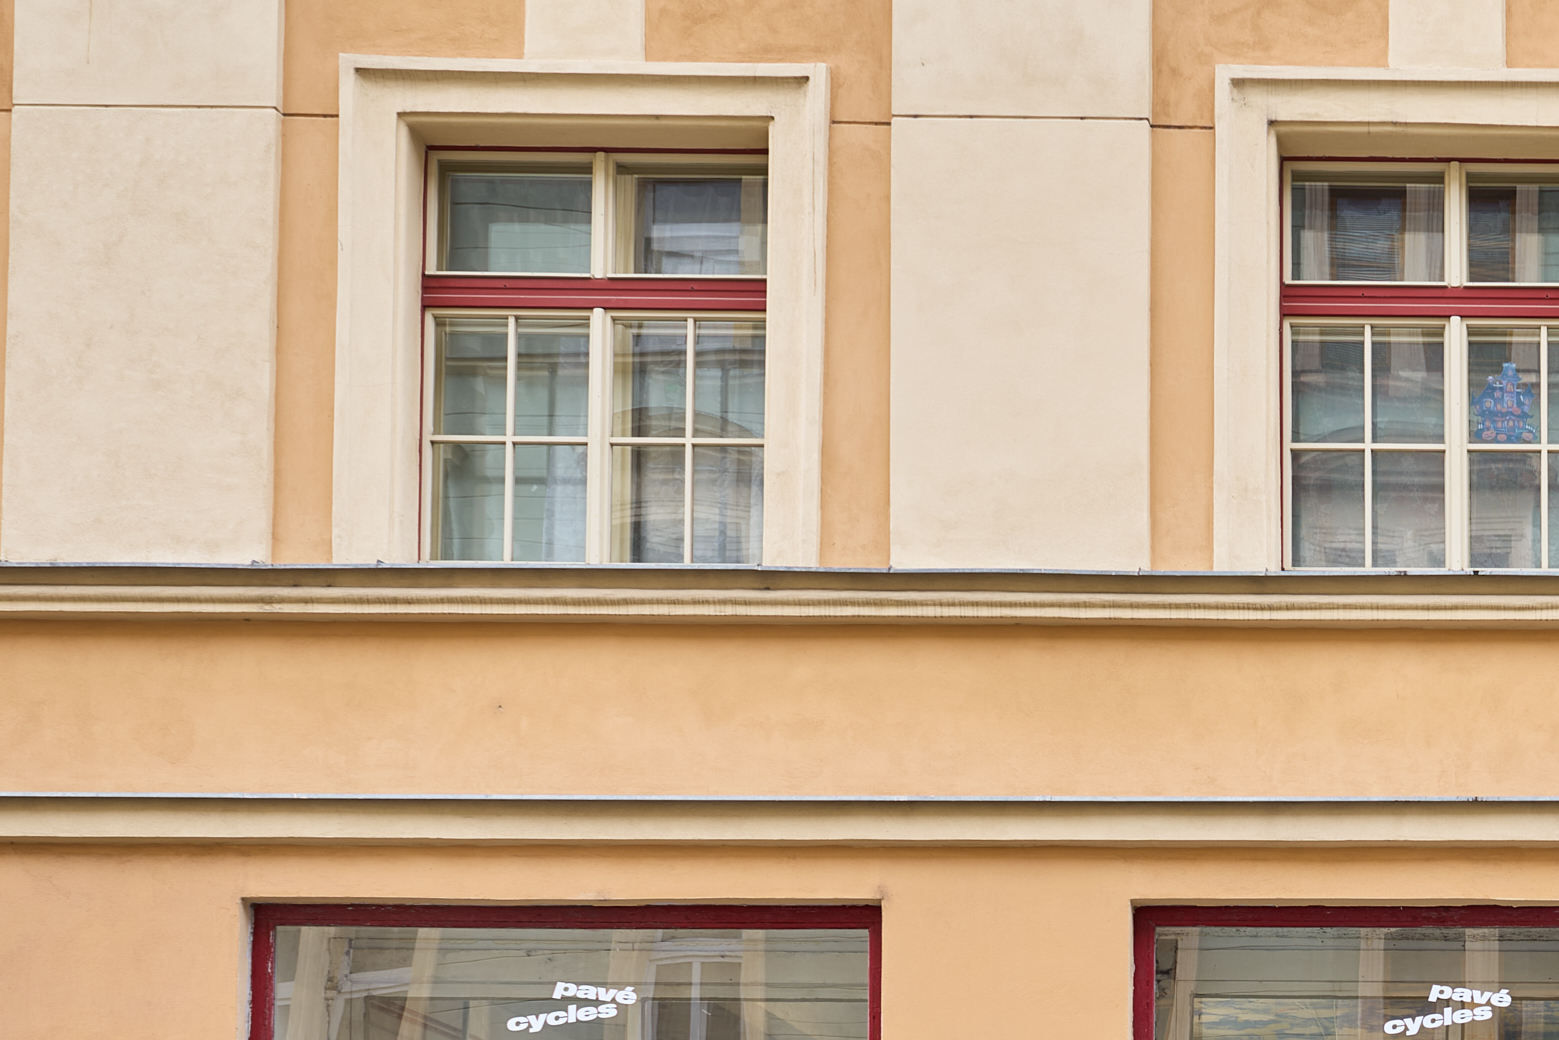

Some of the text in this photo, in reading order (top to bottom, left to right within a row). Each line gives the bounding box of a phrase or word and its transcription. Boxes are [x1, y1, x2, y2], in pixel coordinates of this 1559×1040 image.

[552, 981, 637, 1005] pavé
[1428, 984, 1512, 1007] pavé
[506, 1003, 618, 1033] cycles
[1383, 1006, 1493, 1036] cycles
